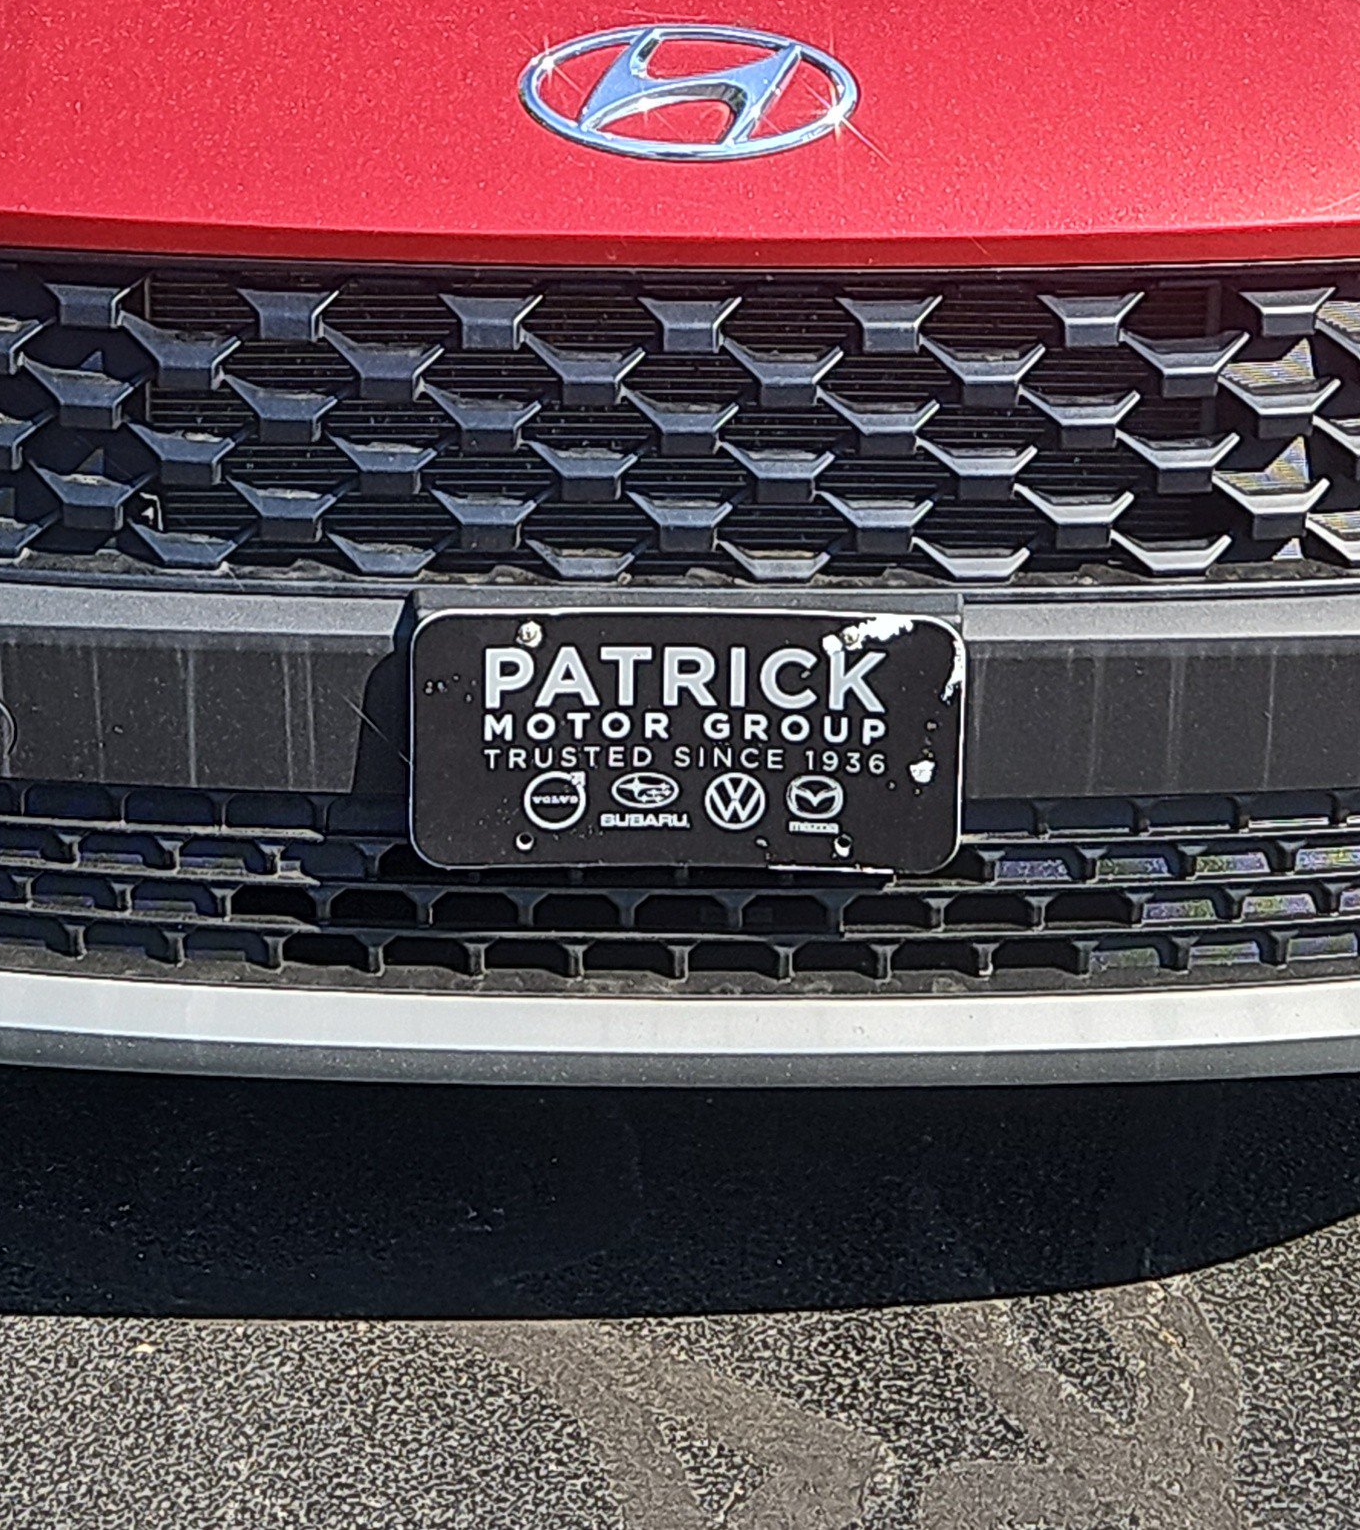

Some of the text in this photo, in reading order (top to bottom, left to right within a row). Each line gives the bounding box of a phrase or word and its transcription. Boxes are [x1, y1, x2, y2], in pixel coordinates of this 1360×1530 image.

[485, 647, 885, 711] PATRICK
[485, 713, 886, 745] MOTOR GROUP
[484, 747, 886, 774] TRUSTED SINCE 1936
[533, 795, 579, 805] VOLVO
[601, 813, 690, 827] SUBARU
